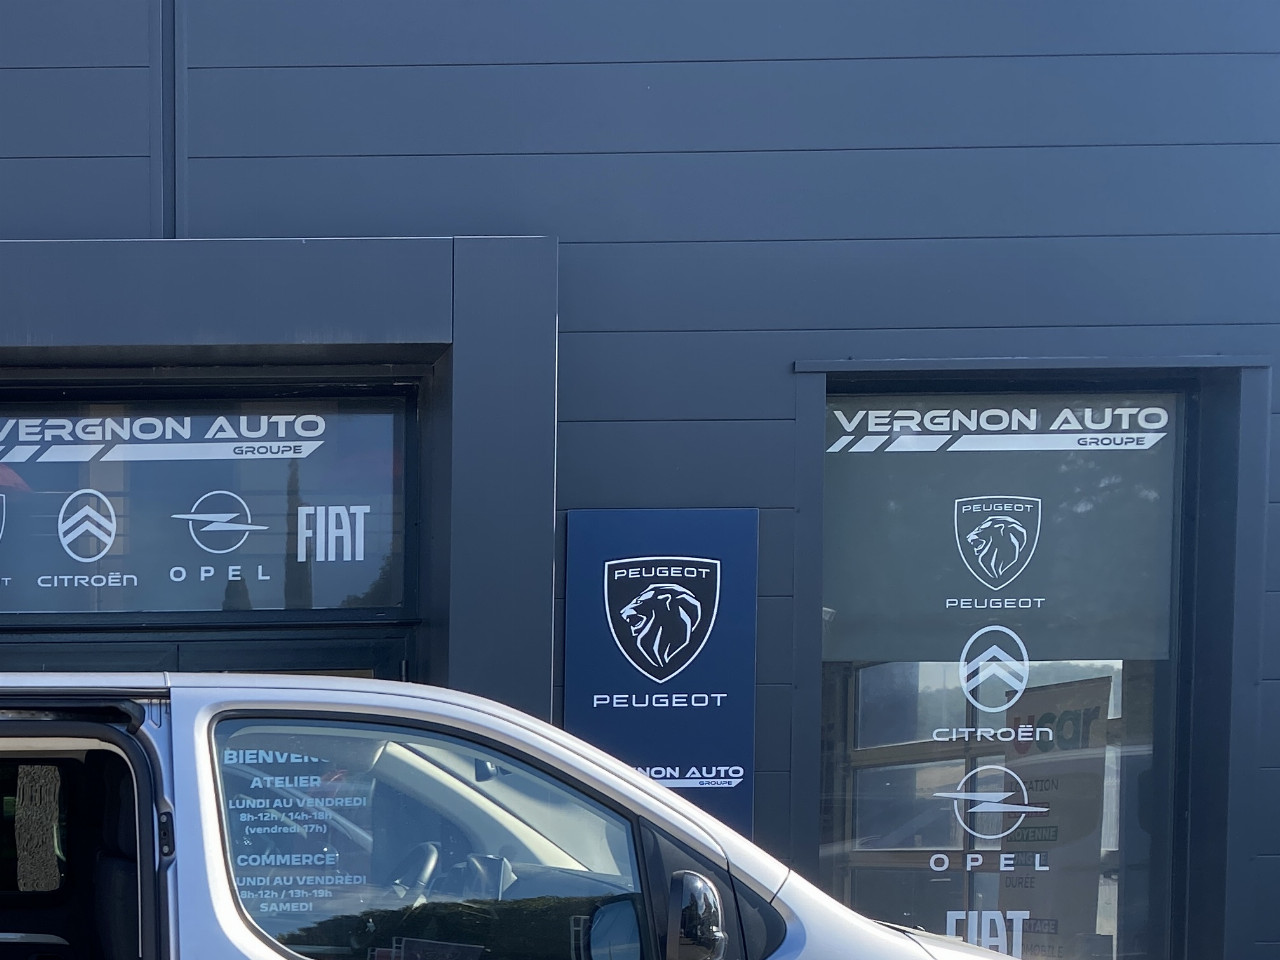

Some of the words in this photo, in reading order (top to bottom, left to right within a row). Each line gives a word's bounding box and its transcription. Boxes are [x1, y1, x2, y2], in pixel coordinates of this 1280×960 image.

[833, 409, 1037, 432] VERGNON
[1049, 407, 1169, 430] AUTO
[203, 414, 326, 439] AUTO
[1077, 437, 1146, 447] GROUPE
[232, 445, 303, 455] GROUPE
[962, 504, 1034, 513] PEUGEOT
[296, 505, 371, 562] FIAT
[169, 565, 270, 582] OPEL
[615, 568, 710, 580] PEUGEOT
[946, 598, 1046, 609] PEUGEOT
[593, 694, 728, 708] PEUGEOT
[685, 766, 745, 778] AUTO
[250, 775, 321, 789] ATELIER
[229, 799, 270, 809] LUNDI
[273, 799, 293, 808] AU
[296, 797, 367, 808] VENDREDI
[239, 812, 278, 822] 8h-12h
[237, 853, 336, 867] COMMERCE
[929, 854, 1050, 872] OPEL
[236, 876, 270, 887] UNDI
[273, 876, 293, 886] AU
[296, 875, 367, 886] VENDREDI
[240, 889, 278, 899] 8h-12h
[288, 889, 333, 898] 13h-19h
[260, 902, 313, 912] SAMEDI
